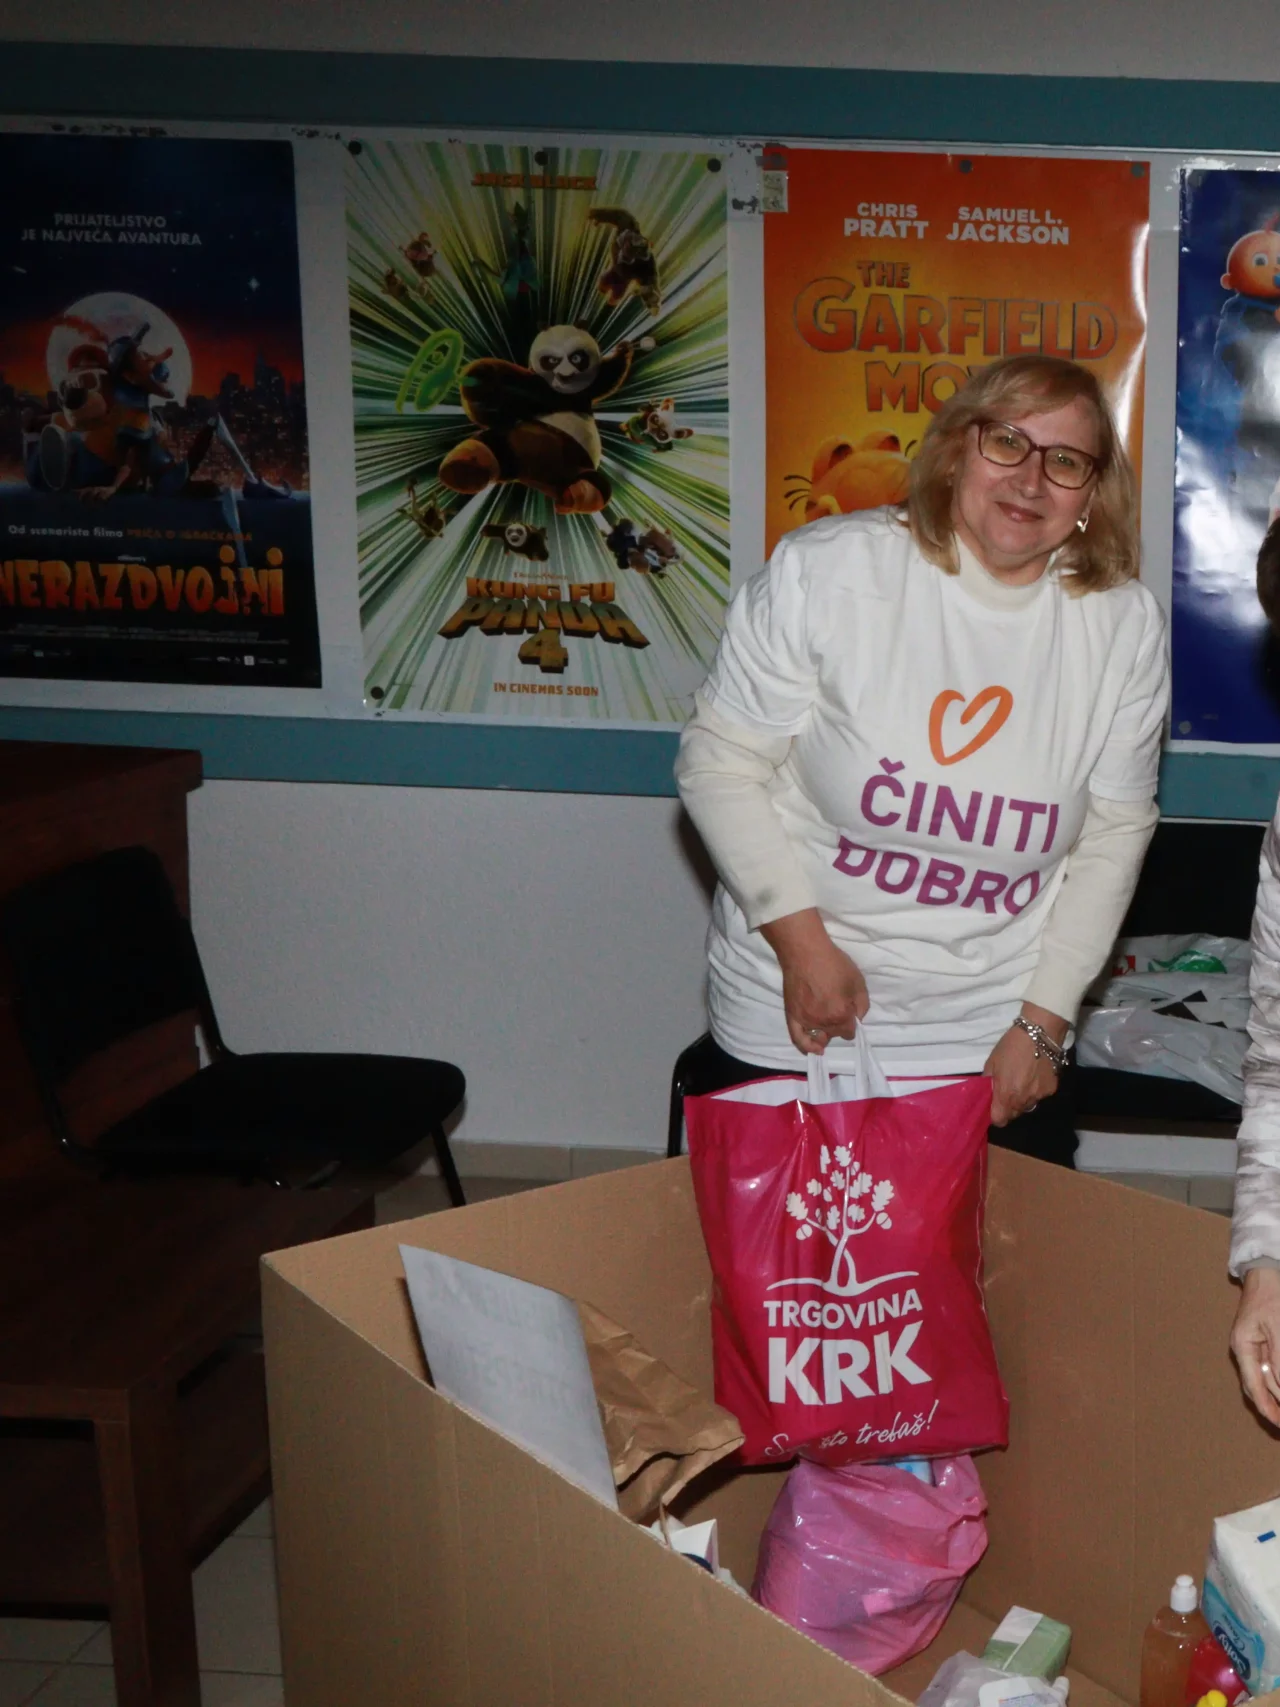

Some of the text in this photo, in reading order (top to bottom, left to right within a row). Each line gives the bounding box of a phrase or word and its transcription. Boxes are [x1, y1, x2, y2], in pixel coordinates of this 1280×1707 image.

[53, 212, 168, 228] PRIJATELJSTVO
[857, 202, 918, 219] CHRIS
[958, 206, 1062, 224] SAMUEL L.
[20, 228, 202, 246] JE NAJVEĆA AVANTURA
[844, 218, 929, 239] PRATT
[946, 222, 1069, 245] JACKSON
[857, 260, 910, 288] THE
[793, 277, 1118, 360] GARFIELD
[8, 524, 26, 535] Od
[466, 576, 561, 600] KUNG
[569, 581, 615, 603] FU
[437, 597, 651, 649] PANDA
[517, 629, 569, 674] 4
[494, 682, 598, 696] IN CINEMAS SOON
[860, 757, 1060, 854] ČINITI
[832, 835, 1041, 916] DOBRO
[763, 1289, 923, 1330] TRGOVINA
[768, 1320, 932, 1406] KRK
